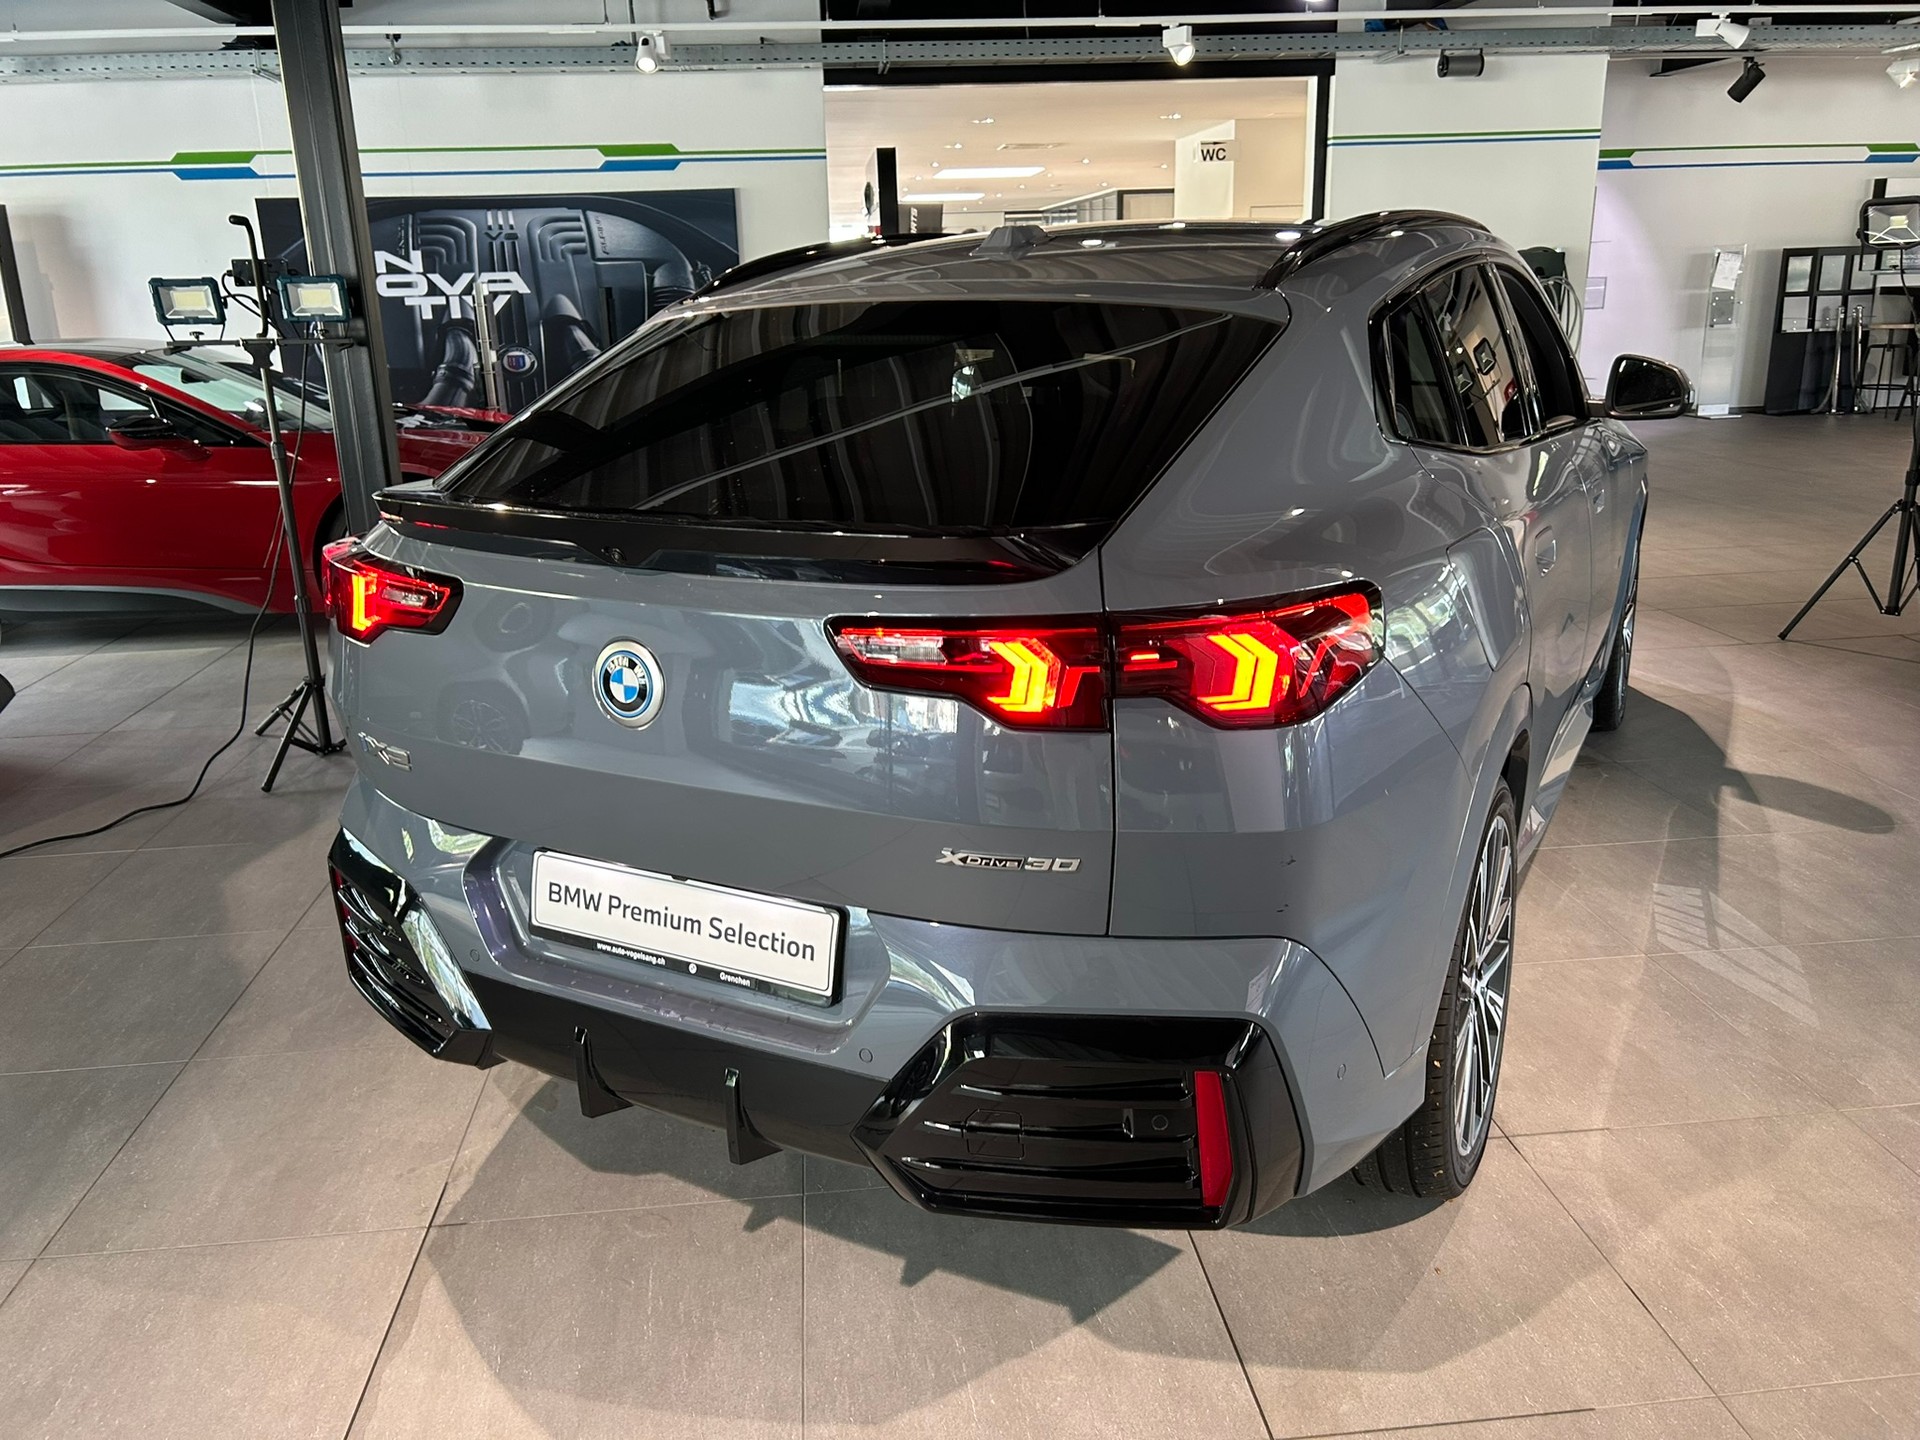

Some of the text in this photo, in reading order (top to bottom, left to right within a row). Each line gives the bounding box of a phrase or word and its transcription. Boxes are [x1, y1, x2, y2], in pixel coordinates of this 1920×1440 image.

[1200, 147, 1226, 161] WC
[606, 655, 648, 686] BMW
[548, 881, 816, 962] BMW Premium Selection
[596, 942, 666, 966] www.auto-vogelsang.ch
